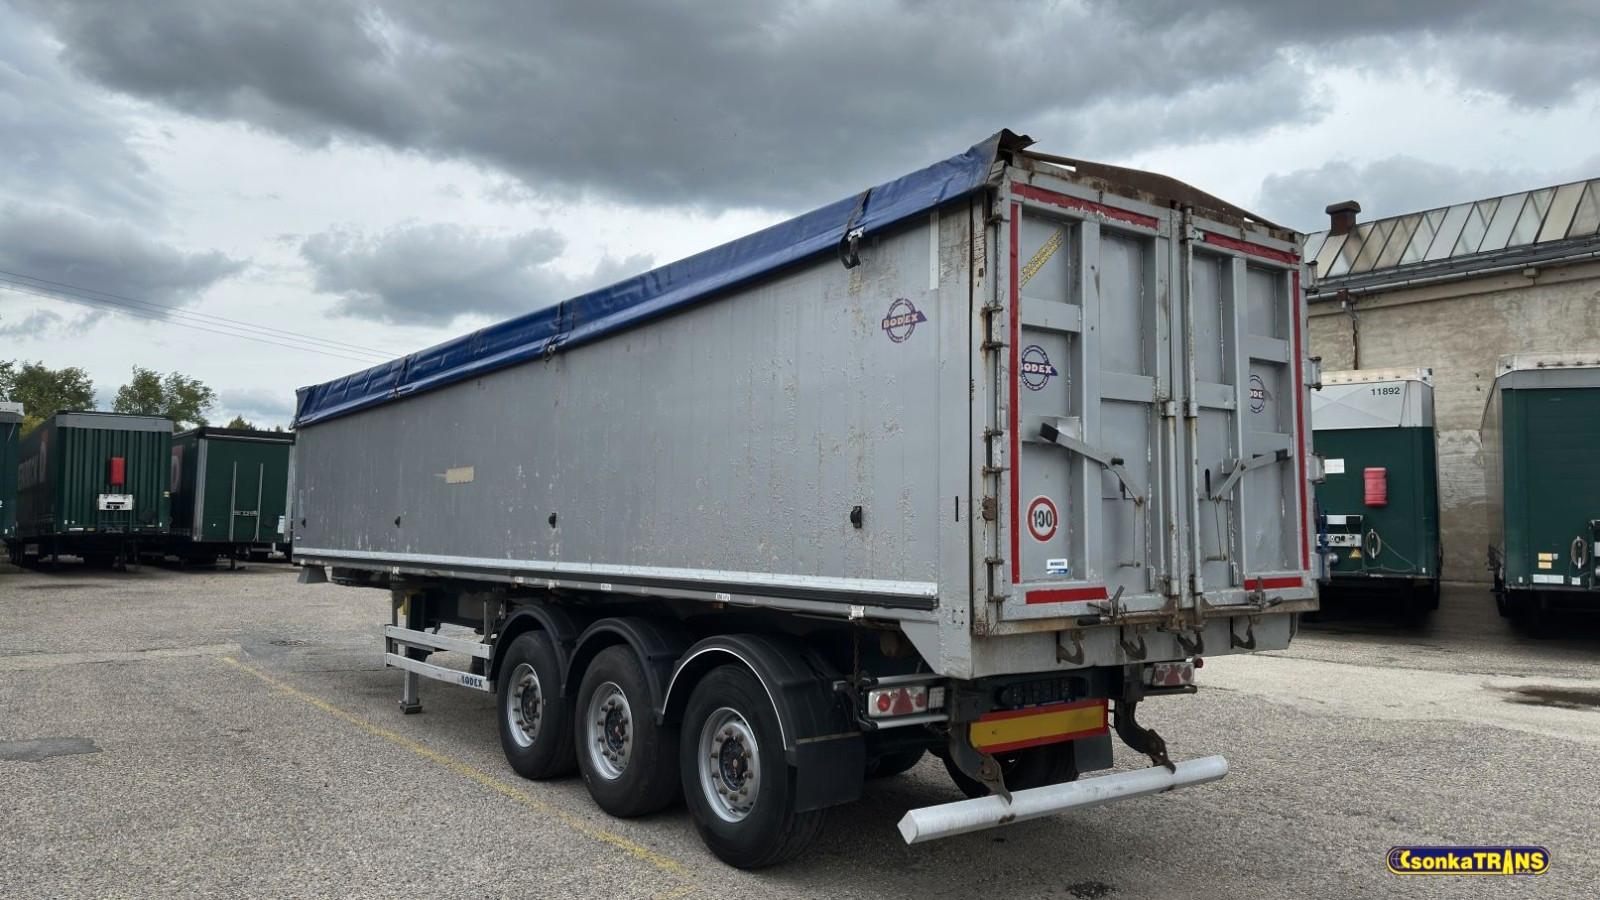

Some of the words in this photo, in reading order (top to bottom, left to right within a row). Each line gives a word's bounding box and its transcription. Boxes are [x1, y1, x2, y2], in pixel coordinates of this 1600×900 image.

[883, 312, 919, 329] BODEX
[1370, 387, 1401, 396] 11892
[1033, 510, 1053, 527] 100
